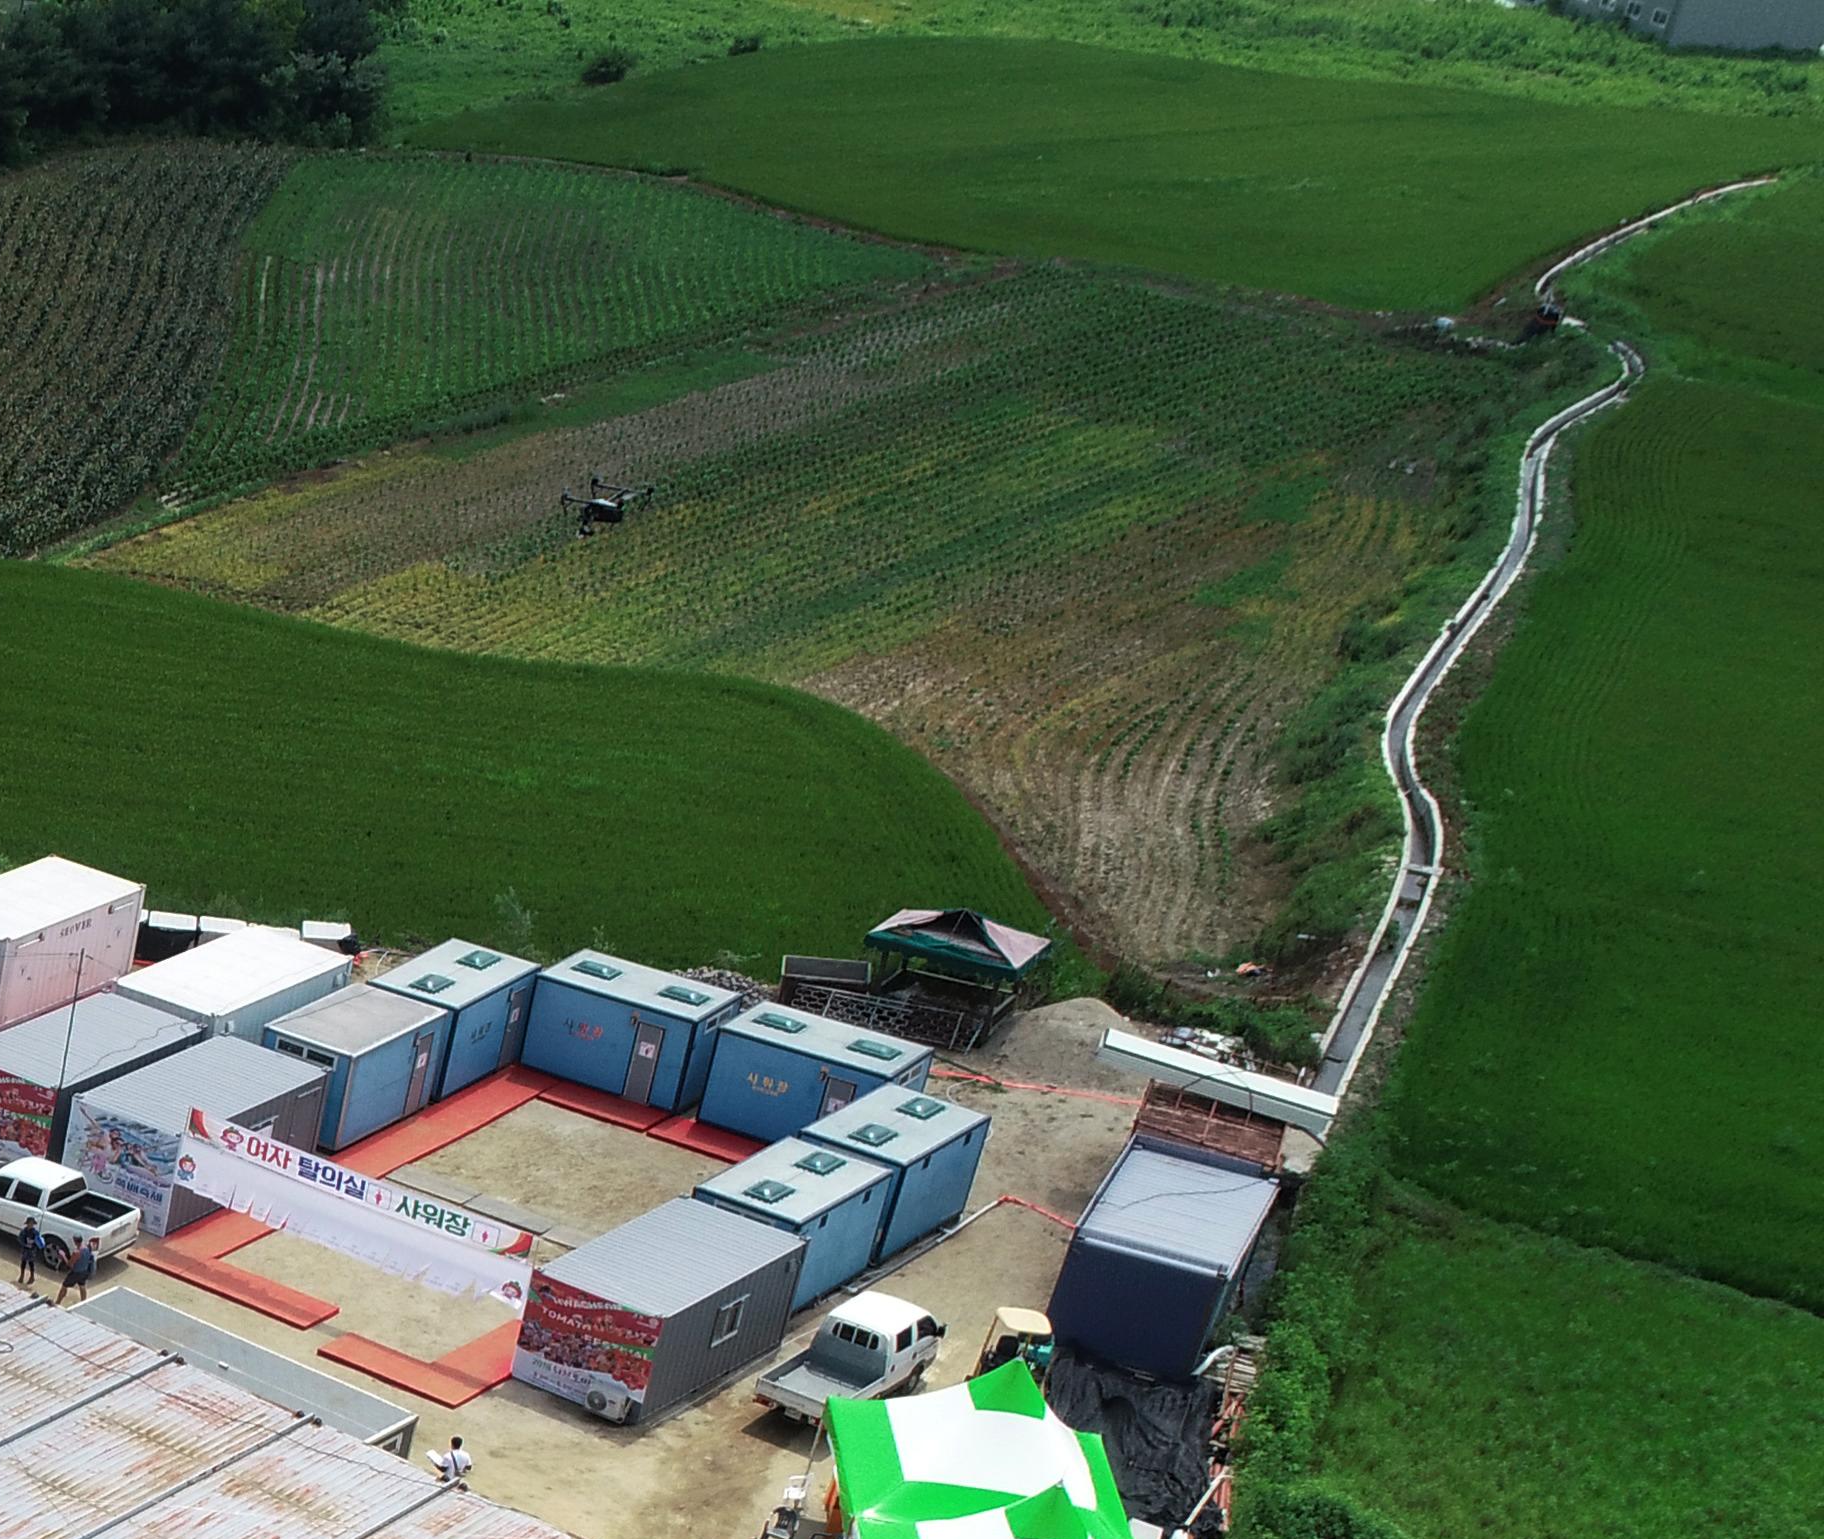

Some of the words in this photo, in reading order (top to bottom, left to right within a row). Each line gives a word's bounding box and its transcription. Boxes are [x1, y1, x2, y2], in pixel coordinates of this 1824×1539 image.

[246, 1135, 293, 1170] 여자
[298, 1155, 367, 1201] 탈의실
[395, 1195, 471, 1238] 샤워장
